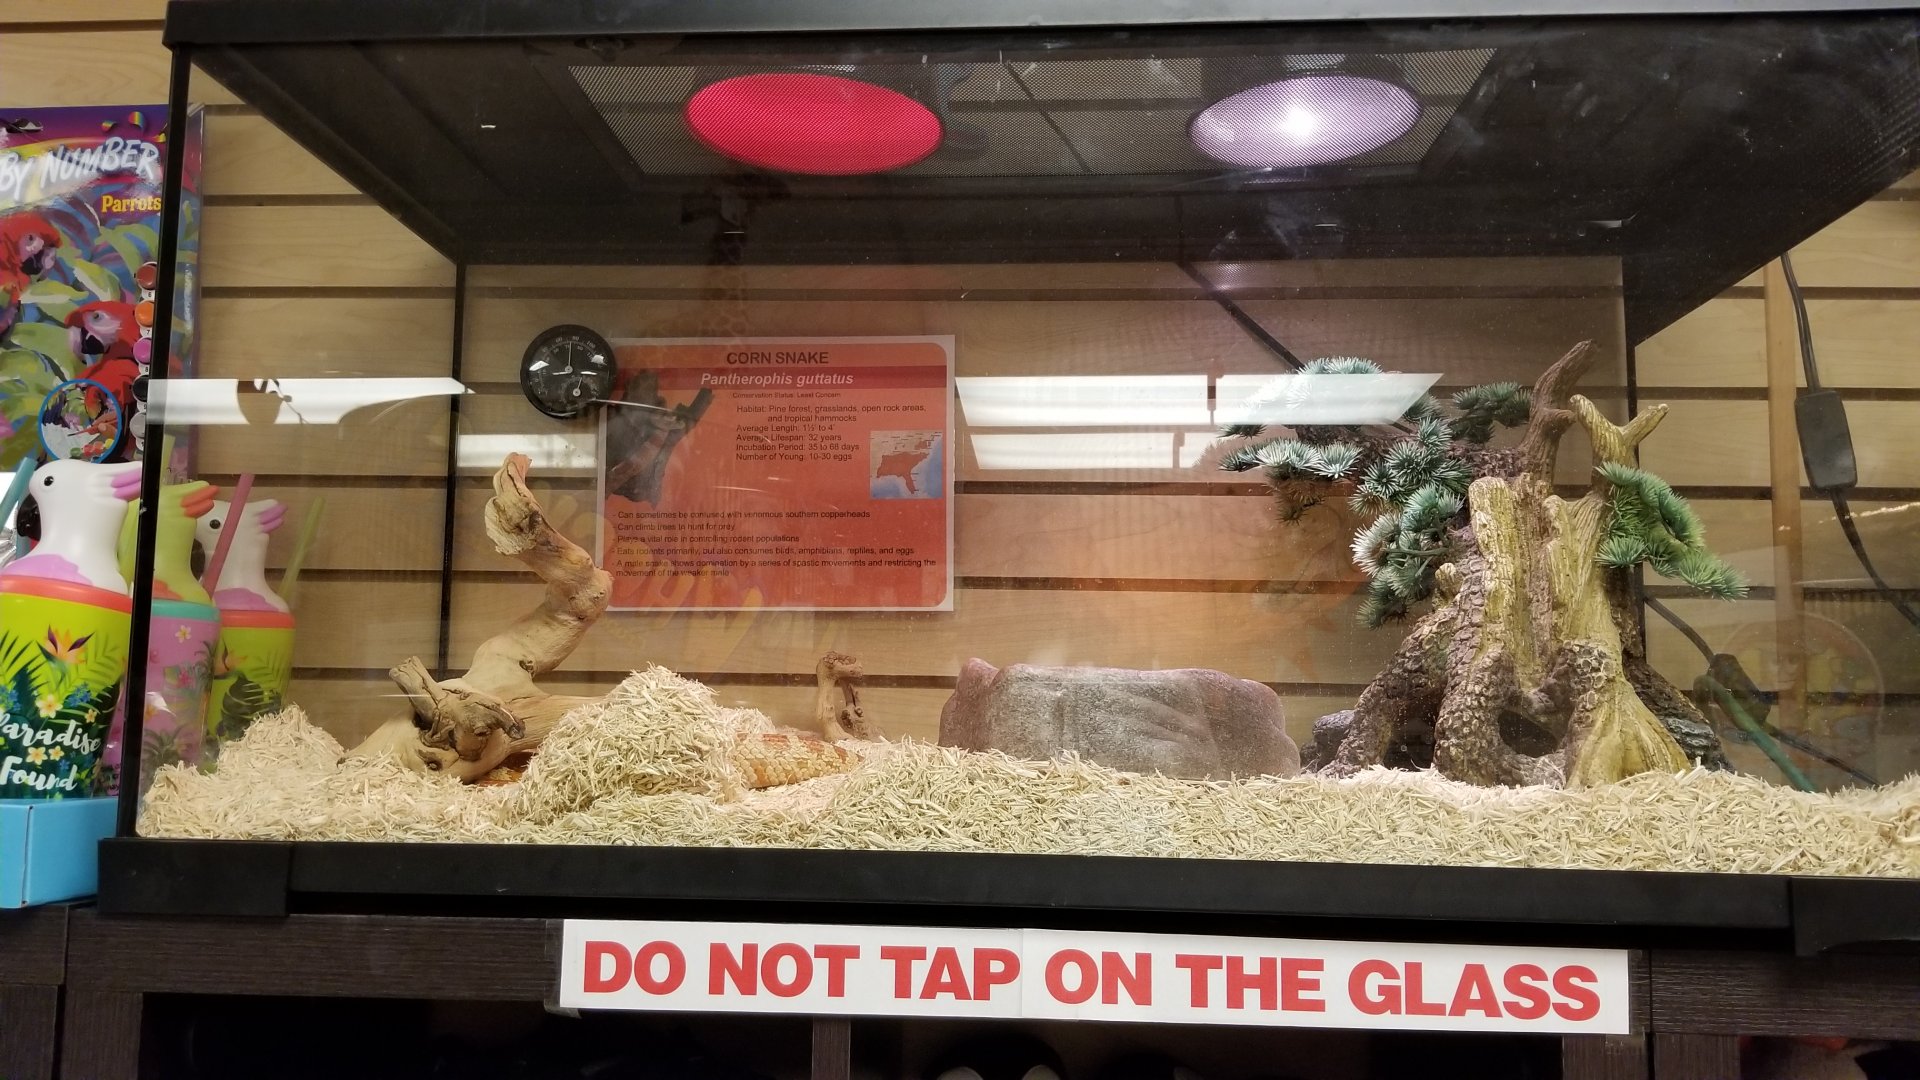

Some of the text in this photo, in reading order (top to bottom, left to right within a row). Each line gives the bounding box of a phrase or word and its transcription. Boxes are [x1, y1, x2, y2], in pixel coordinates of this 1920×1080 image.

[40, 136, 160, 189] NUMBER
[101, 195, 162, 212] Parrots
[726, 351, 830, 365] CORN SNAKE
[701, 373, 854, 387] Pantherophis guttatus
[736, 404, 767, 413] Habitat:
[769, 404, 787, 412] Pine
[788, 404, 813, 414] forest,
[861, 405, 881, 414] open
[883, 404, 900, 412] rock
[901, 404, 926, 412] areas,
[768, 414, 857, 424] and tropical hammocks
[736, 424, 769, 433] Average
[771, 424, 800, 433] Length:
[818, 424, 827, 432] to
[736, 433, 768, 443] Average
[808, 433, 819, 441] 32
[820, 434, 842, 443] years
[736, 443, 776, 451] Incubation
[808, 443, 818, 451] 35
[820, 443, 828, 451] to
[841, 443, 860, 452] days
[736, 453, 767, 461] Number
[768, 453, 777, 461] of
[809, 453, 832, 461] 10-30
[833, 454, 853, 463] eggs
[617, 511, 634, 519] Can
[635, 511, 677, 519] sometimes
[678, 511, 688, 519] be
[820, 510, 871, 520] copperheads
[617, 523, 634, 531] Can
[635, 523, 655, 531] climb
[687, 523, 705, 531] hunt
[706, 523, 717, 531] for
[680, 535, 688, 543] in
[755, 535, 800, 545] populations
[702, 547, 716, 555] but
[716, 547, 733, 555] also
[734, 547, 774, 555] consumes
[878, 546, 893, 554] and
[895, 547, 915, 556] eggs
[616, 560, 623, 568] A
[739, 559, 749, 569] by
[758, 559, 781, 567] series
[782, 559, 791, 567] of
[792, 558, 820, 568] spastic
[867, 558, 882, 567] and
[884, 558, 922, 569] restricting
[923, 558, 937, 567] the
[0, 755, 78, 791] Found
[583, 940, 1601, 1022] DO NOT TAP ON THE GLASS
